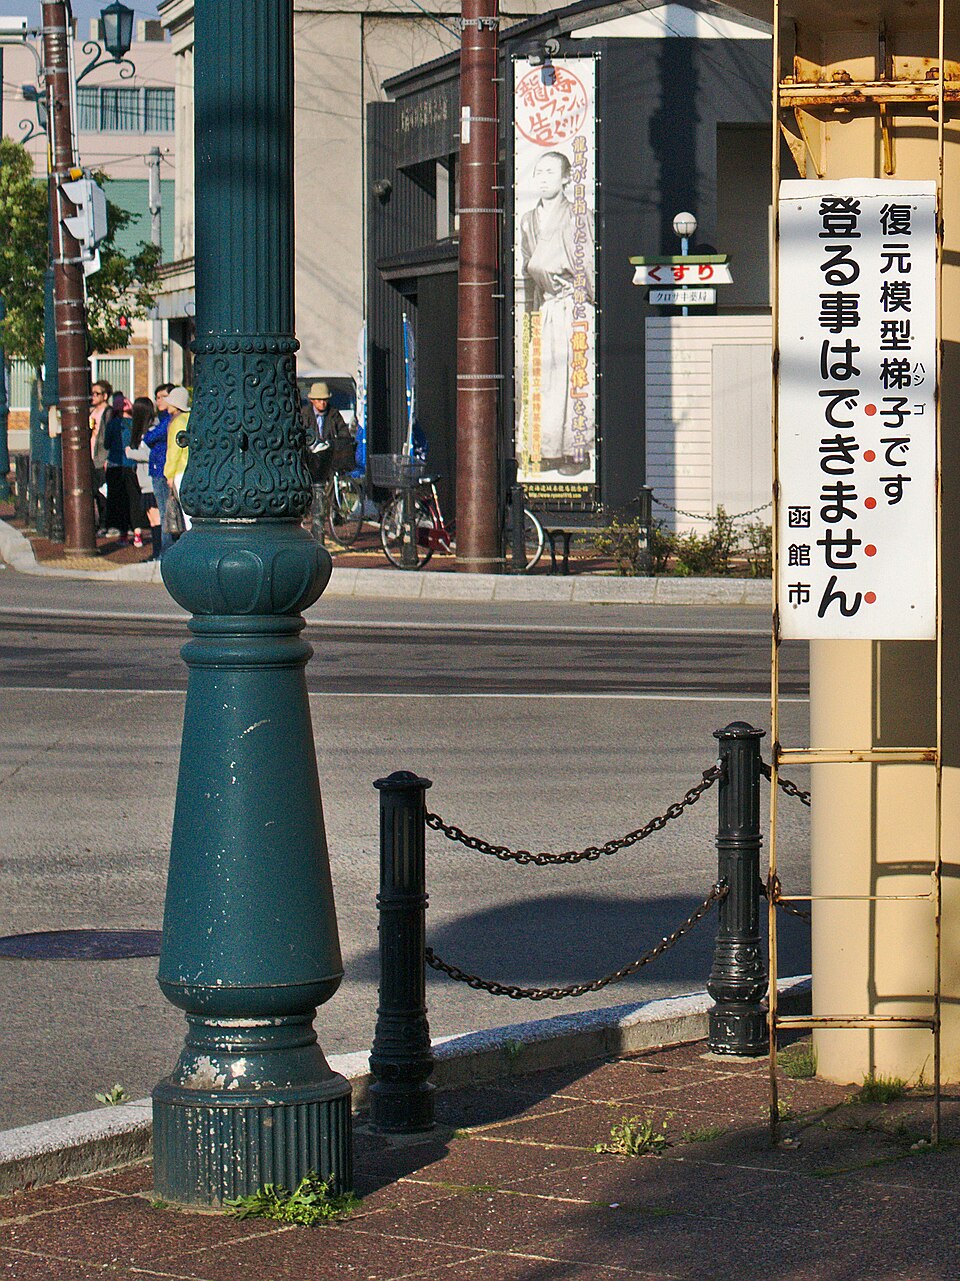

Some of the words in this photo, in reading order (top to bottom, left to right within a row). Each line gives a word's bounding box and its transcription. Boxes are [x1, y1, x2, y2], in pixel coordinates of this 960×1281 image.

[648, 264, 714, 281] くすり
[879, 203, 912, 506] 復元模型梯子です
[817, 197, 862, 618] 登る事はできません
[788, 505, 812, 605] 函館市
